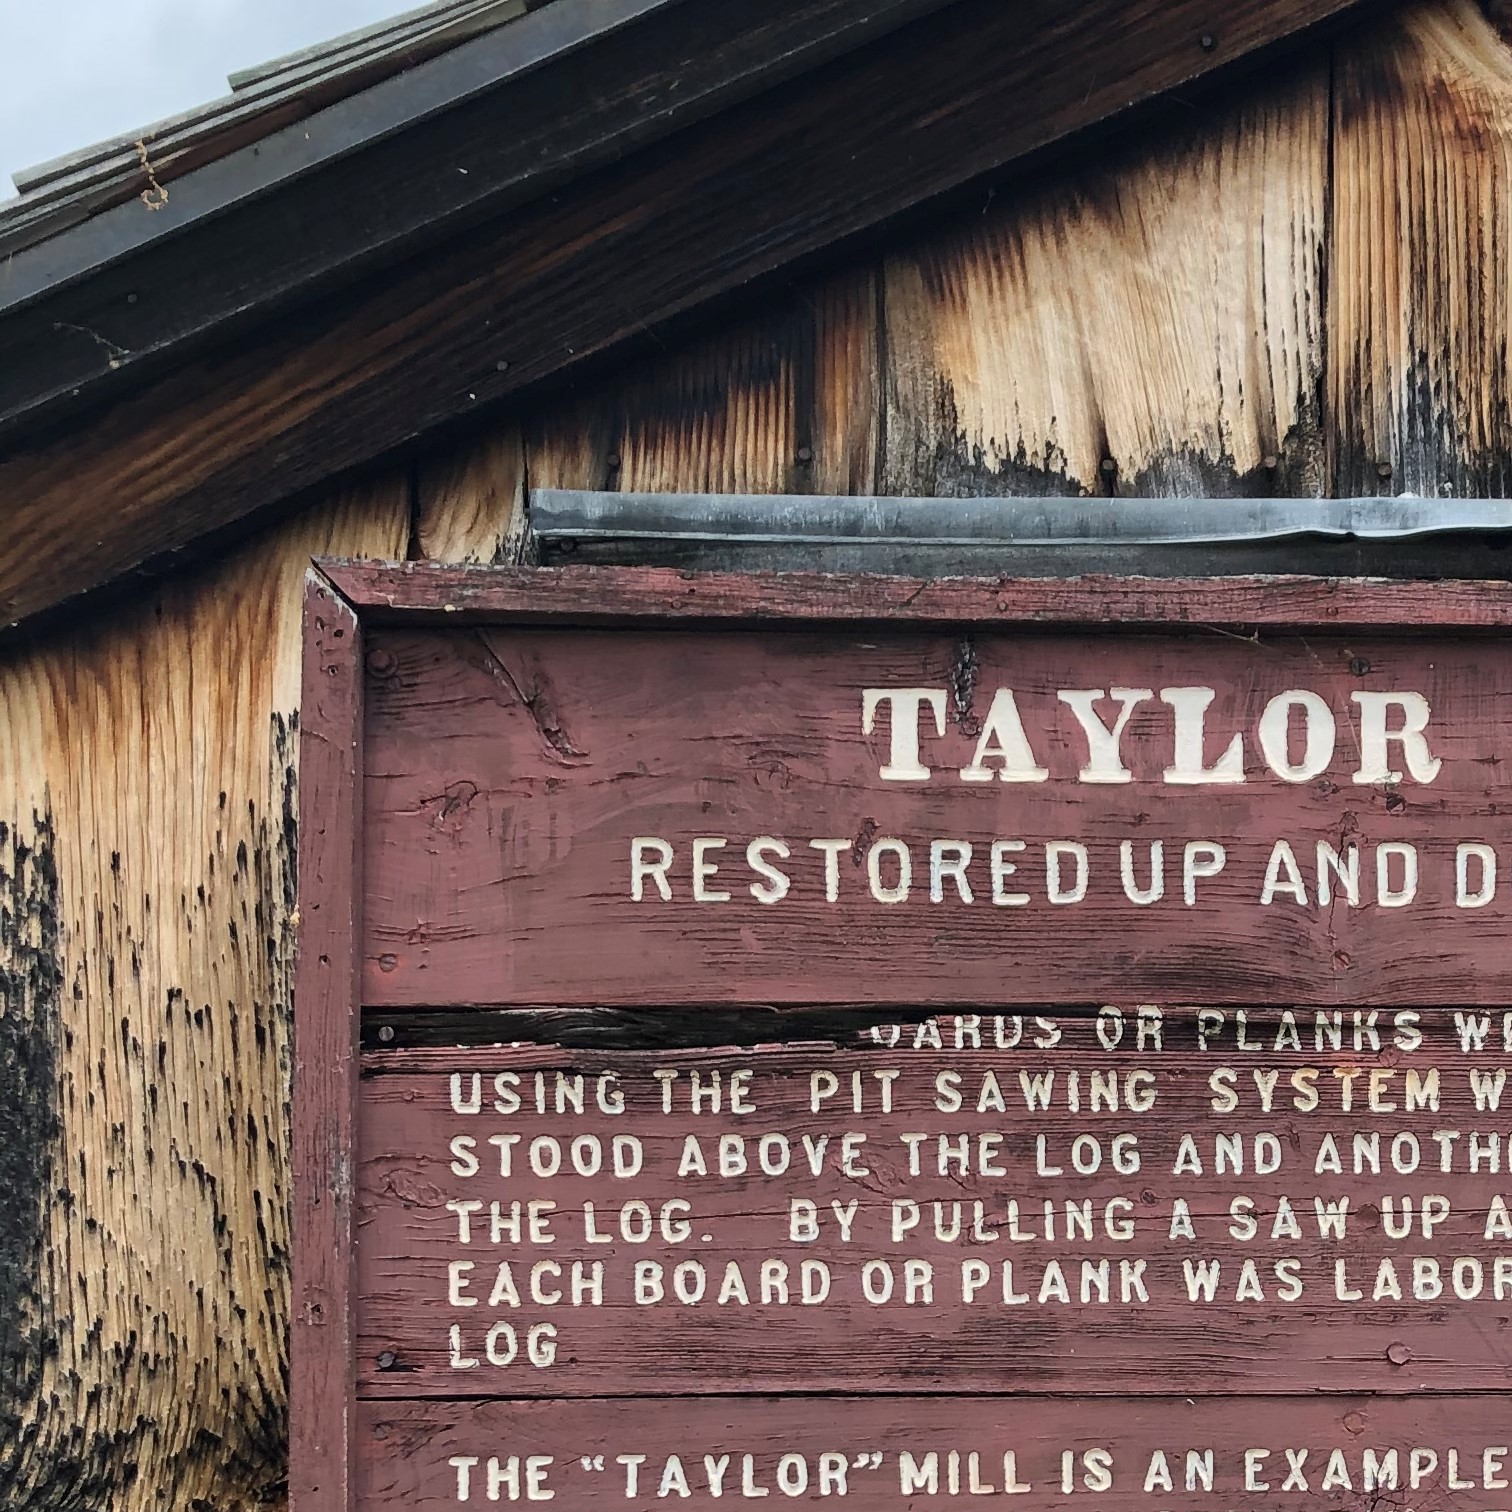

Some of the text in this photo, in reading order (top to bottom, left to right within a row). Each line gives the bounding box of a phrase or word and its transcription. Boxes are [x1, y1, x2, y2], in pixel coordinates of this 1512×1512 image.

[862, 687, 1441, 785] TAYLOR
[631, 836, 1089, 905] RESTORED
[1120, 840, 1226, 906] UP
[1260, 840, 1418, 907] AND
[1096, 1005, 1162, 1051] OR
[1199, 1007, 1422, 1052] PLANKS
[450, 1070, 624, 1114] USING
[654, 1070, 756, 1114] THE
[810, 1070, 899, 1113] PIT
[936, 1070, 1158, 1113] SAWING
[1209, 1062, 1440, 1113] SYSTEM
[450, 1135, 642, 1178] STOOD
[678, 1132, 869, 1178] ABOVE
[900, 1133, 1006, 1176] THE
[1037, 1134, 1140, 1176] LOG
[1171, 1133, 1281, 1176] AND
[446, 1199, 556, 1244] THE
[584, 1199, 712, 1244] LOG.
[790, 1199, 858, 1242] BY
[892, 1197, 1134, 1242] PULLING
[1169, 1199, 1195, 1240] A
[1229, 1196, 1349, 1241] SAW
[1382, 1195, 1450, 1239] UP
[448, 1260, 604, 1307] EACH
[635, 1259, 830, 1305] BOARD
[862, 1260, 934, 1304] OR
[961, 1259, 1149, 1305] PLANK
[1183, 1259, 1302, 1302] WAS
[449, 1321, 557, 1368] LOG
[448, 1456, 555, 1501] THE
[899, 1450, 1031, 1495] MILL
[1062, 1448, 1113, 1494] IS
[1144, 1450, 1213, 1492] AN
[1245, 1447, 1508, 1492] EXAMPLE
